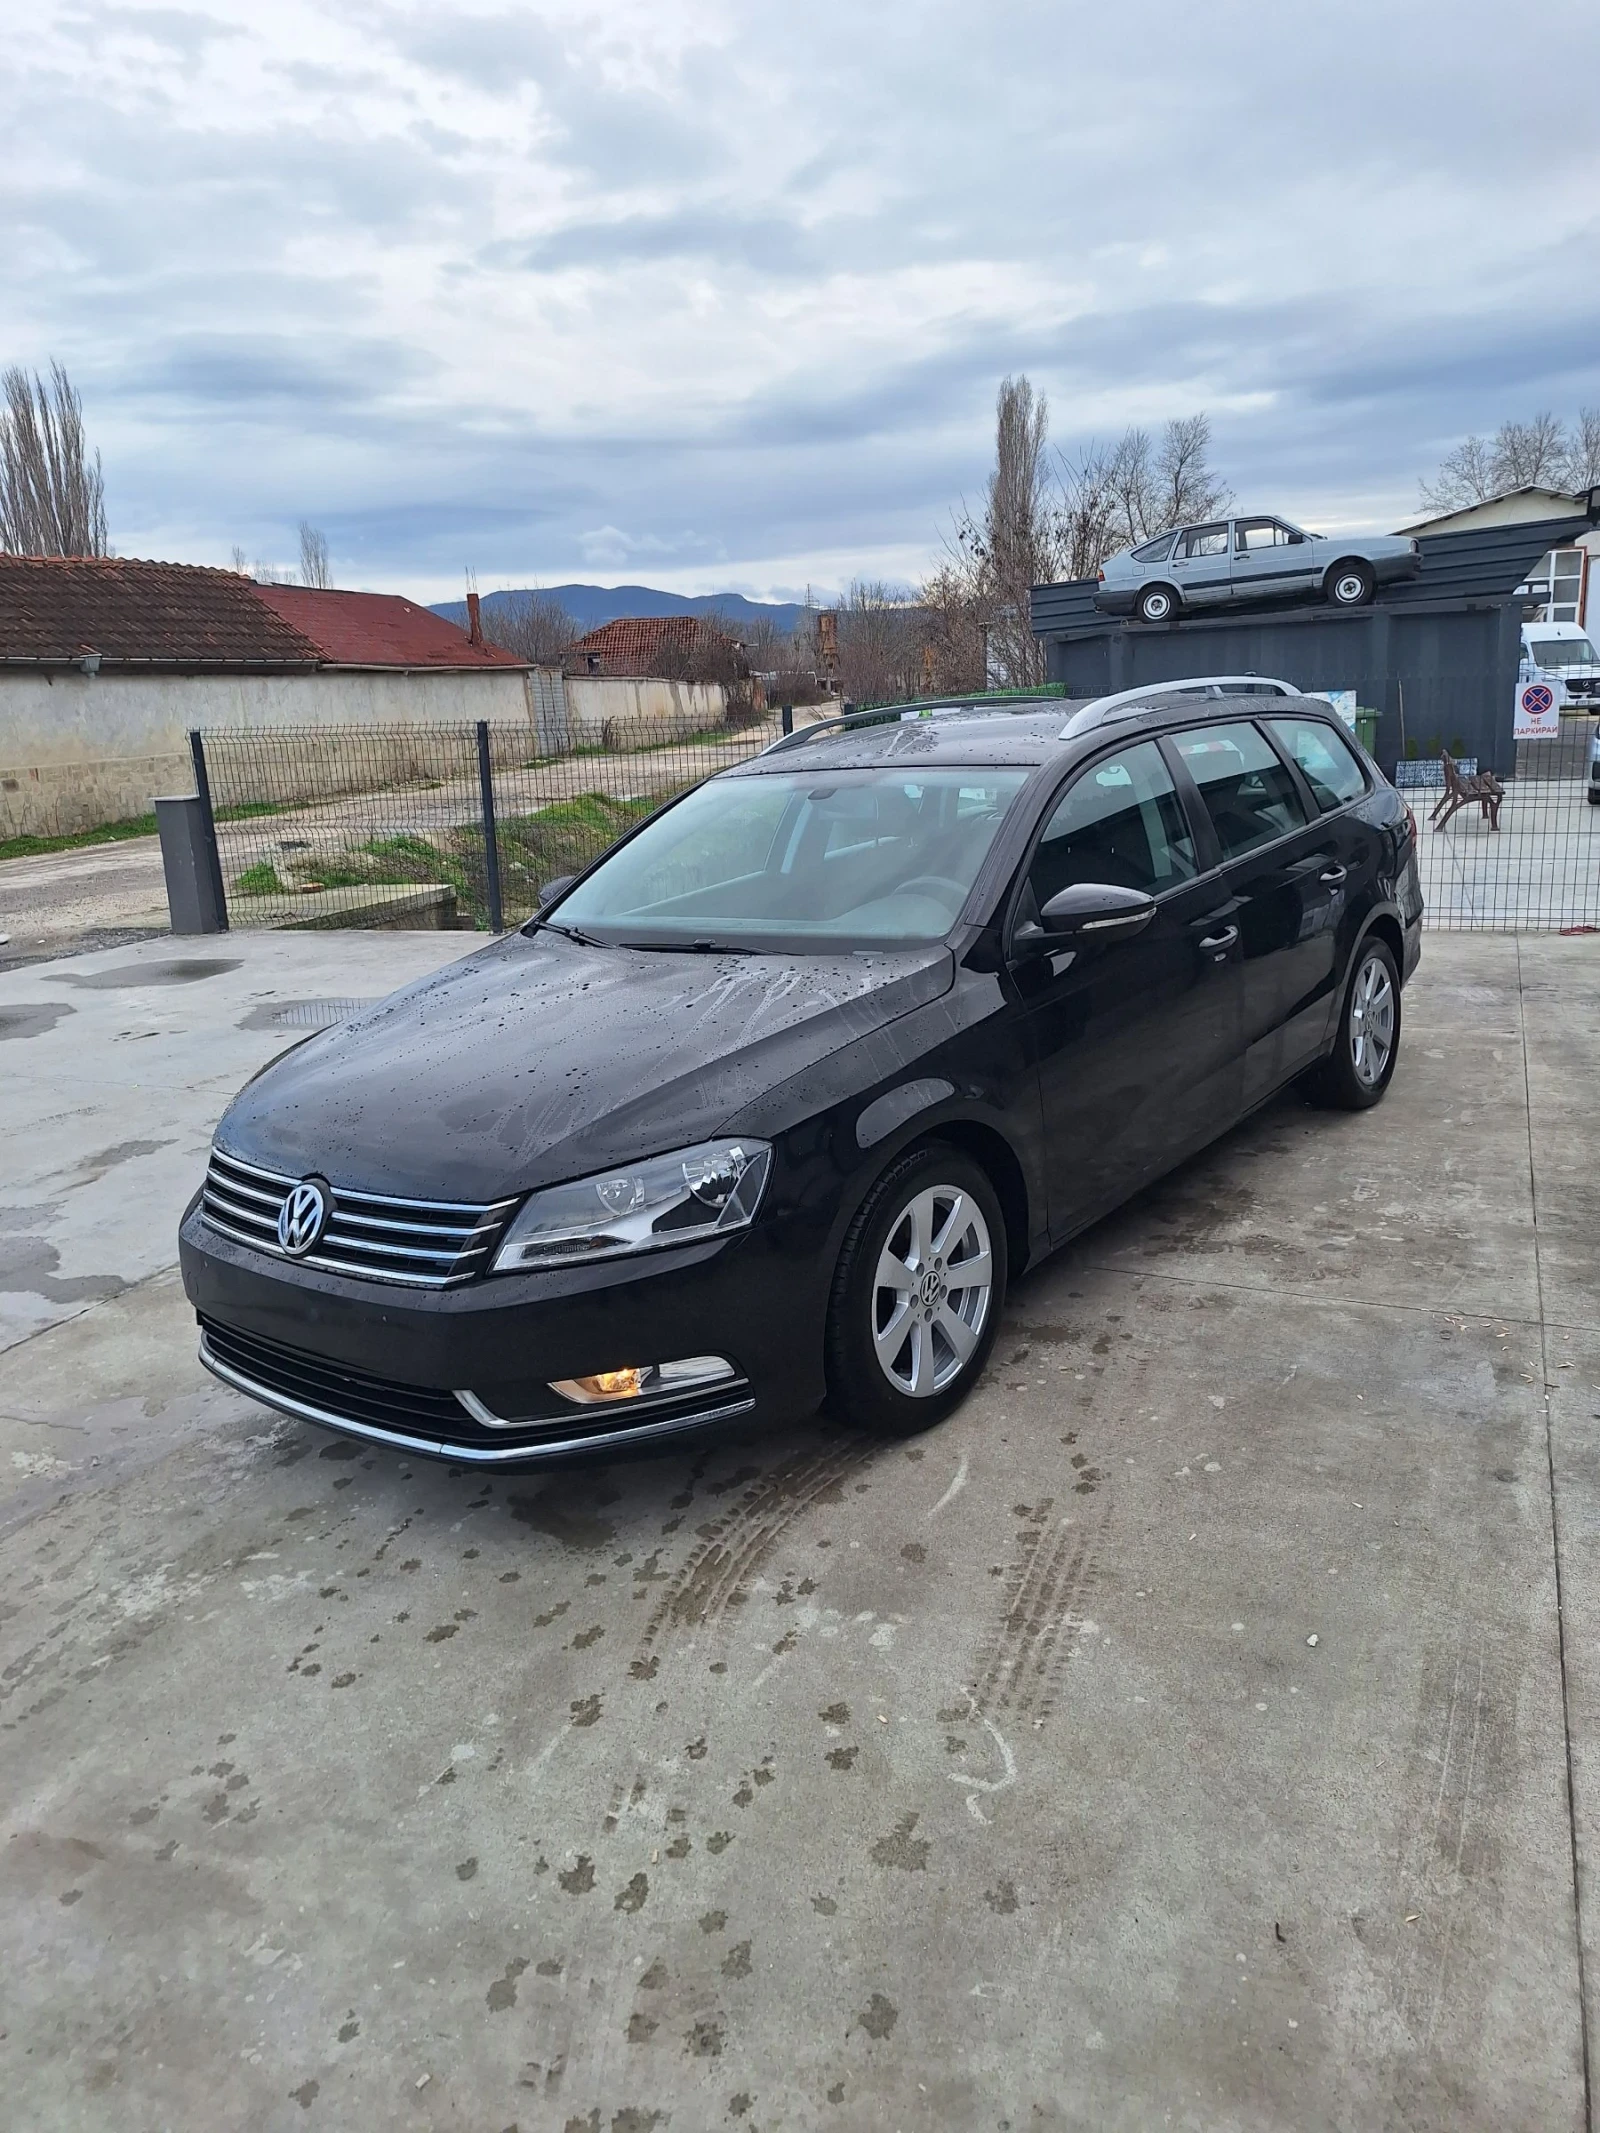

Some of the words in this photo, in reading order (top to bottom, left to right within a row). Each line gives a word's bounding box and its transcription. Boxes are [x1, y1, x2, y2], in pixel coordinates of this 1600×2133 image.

[1514, 725, 1558, 736] ПАРКИРАЙ
[1530, 717, 1542, 725] НЕ
[278, 1184, 324, 1254] VW
[920, 1270, 941, 1307] VW
